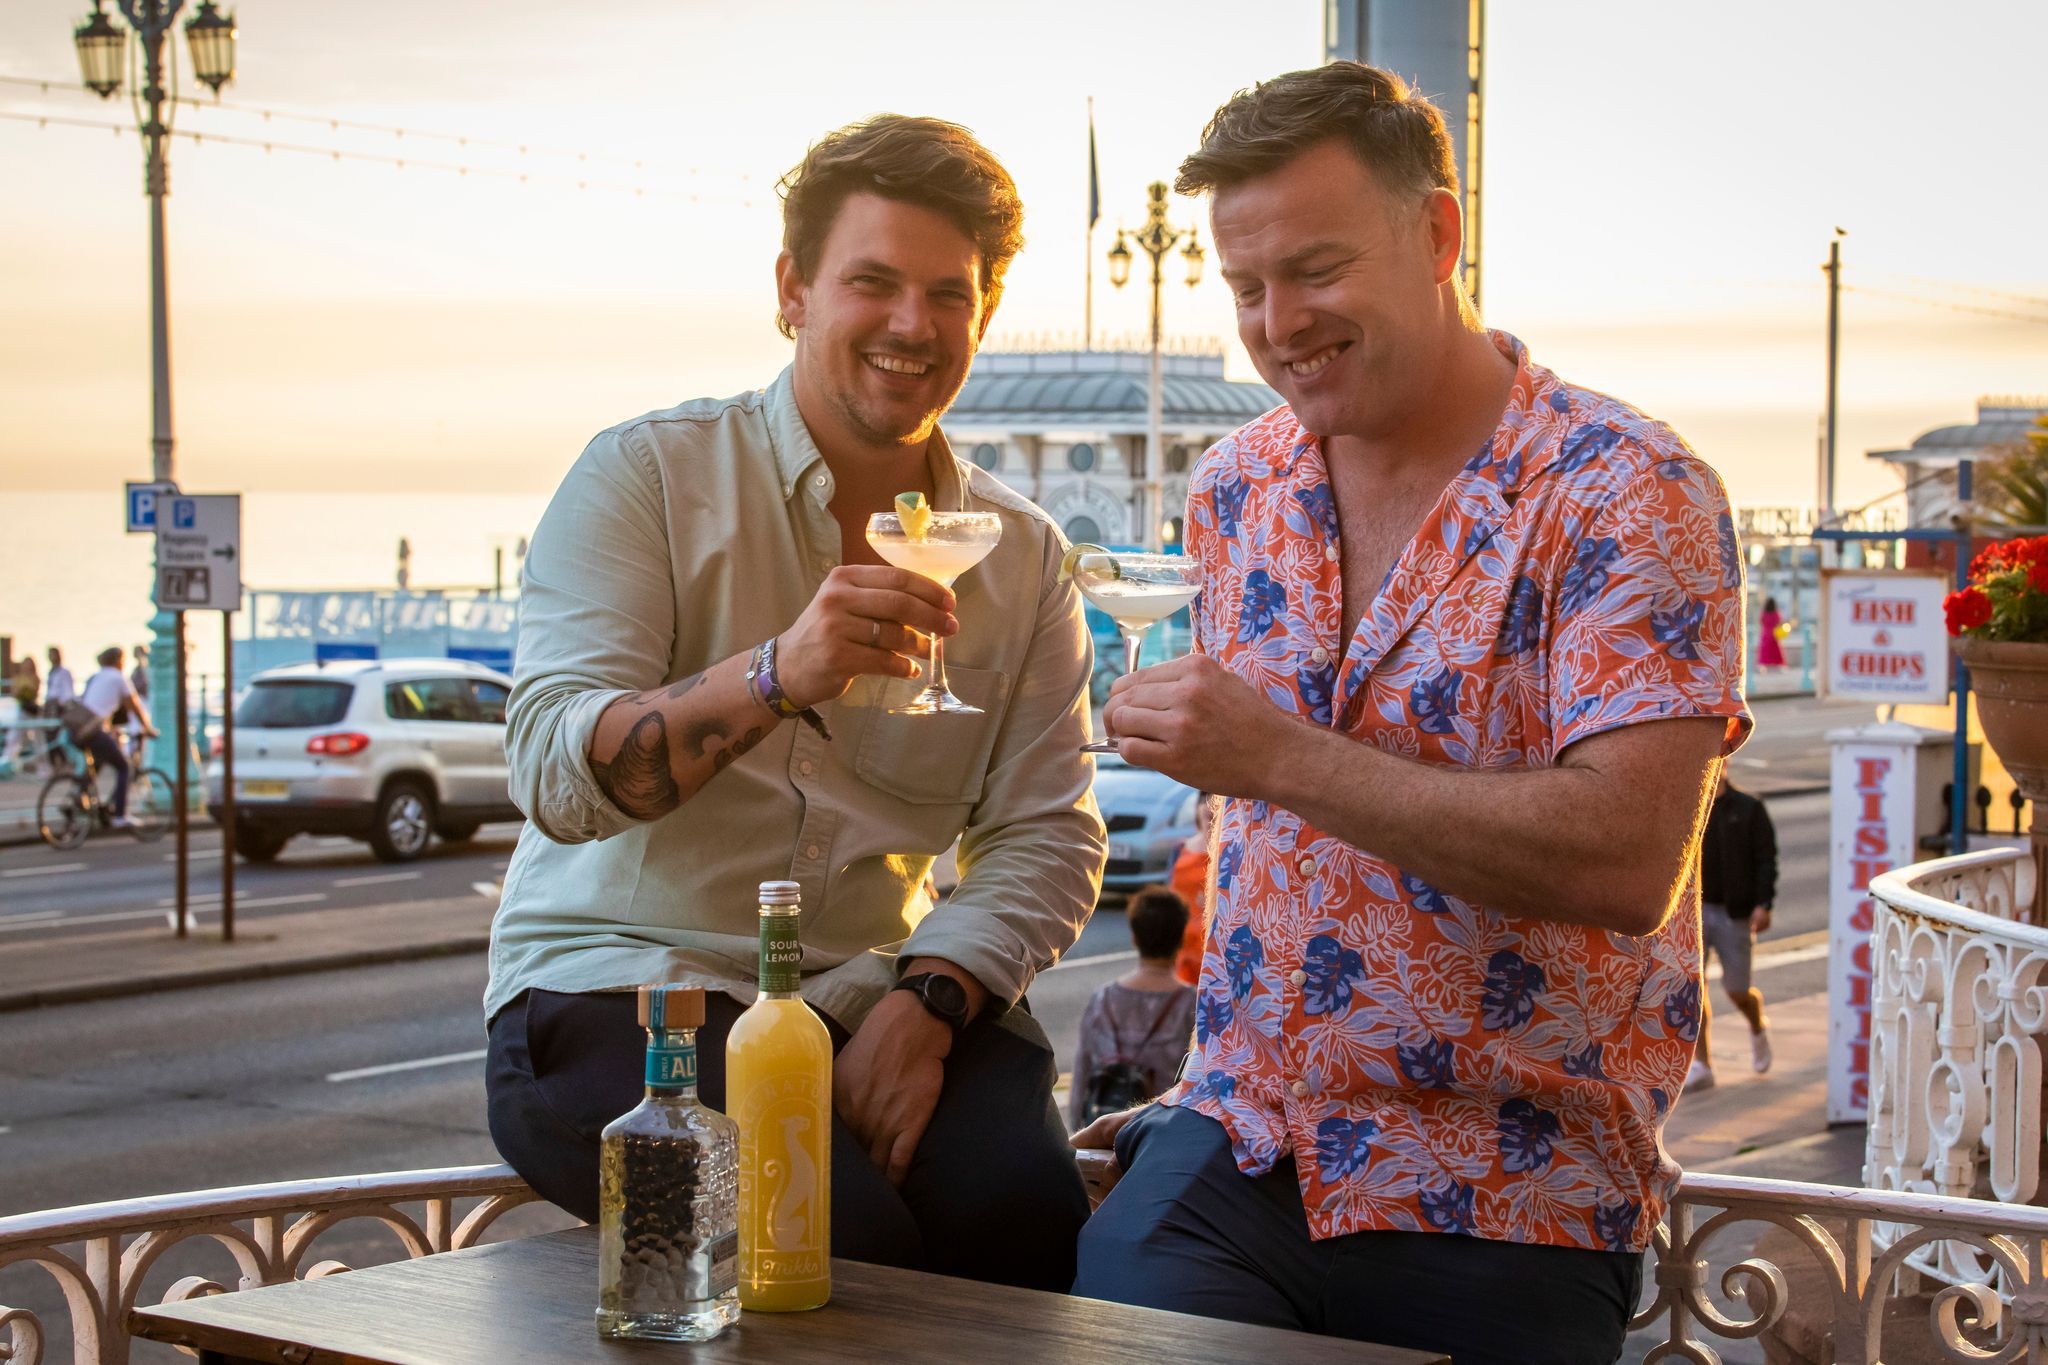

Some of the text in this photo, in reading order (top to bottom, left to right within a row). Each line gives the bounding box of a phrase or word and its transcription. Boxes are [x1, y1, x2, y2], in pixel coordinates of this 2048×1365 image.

[1851, 600, 1916, 624] FISH
[1873, 629, 1890, 646] &
[1841, 652, 1924, 677] CHIPS
[769, 941, 798, 951] SOUR
[765, 953, 801, 963] LEMON
